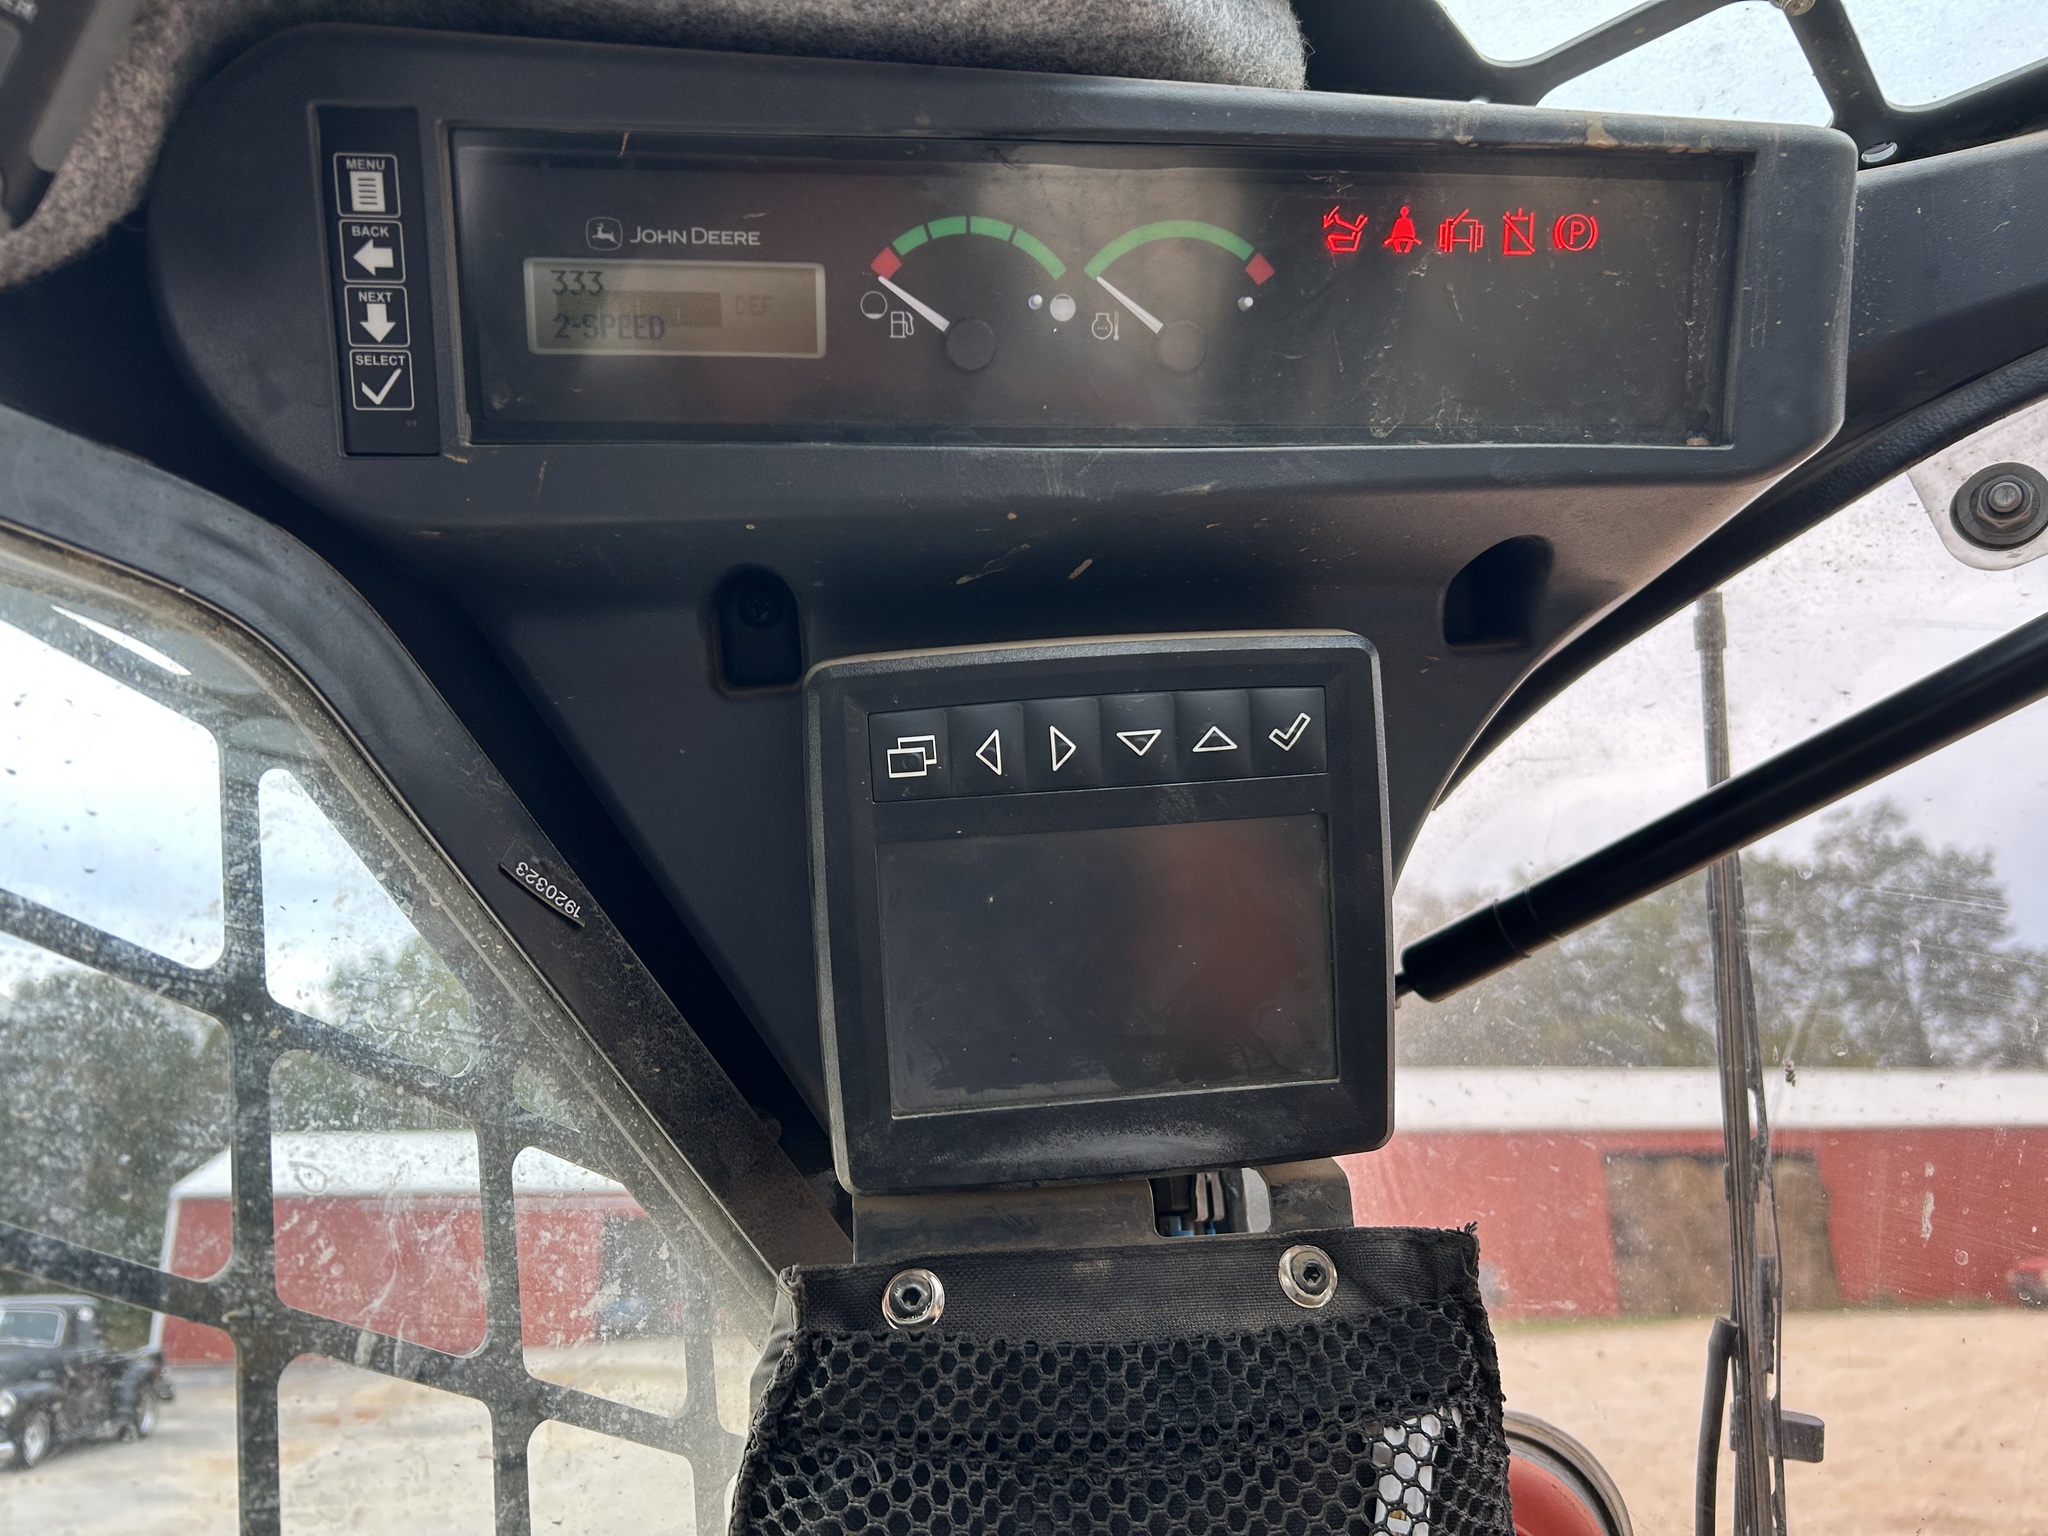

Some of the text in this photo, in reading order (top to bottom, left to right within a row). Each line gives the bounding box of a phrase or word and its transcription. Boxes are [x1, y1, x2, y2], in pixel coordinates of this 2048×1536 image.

[345, 159, 385, 170] MENU
[351, 226, 390, 237] BACK
[629, 226, 761, 246] JOHN DEERE
[1569, 221, 1586, 245] P
[550, 270, 604, 297] 333
[358, 291, 393, 303] NEXT
[735, 295, 773, 316] DEF
[552, 313, 666, 340] 2-SPEED
[355, 355, 406, 366] SELECT
[515, 861, 581, 919] 1920323
